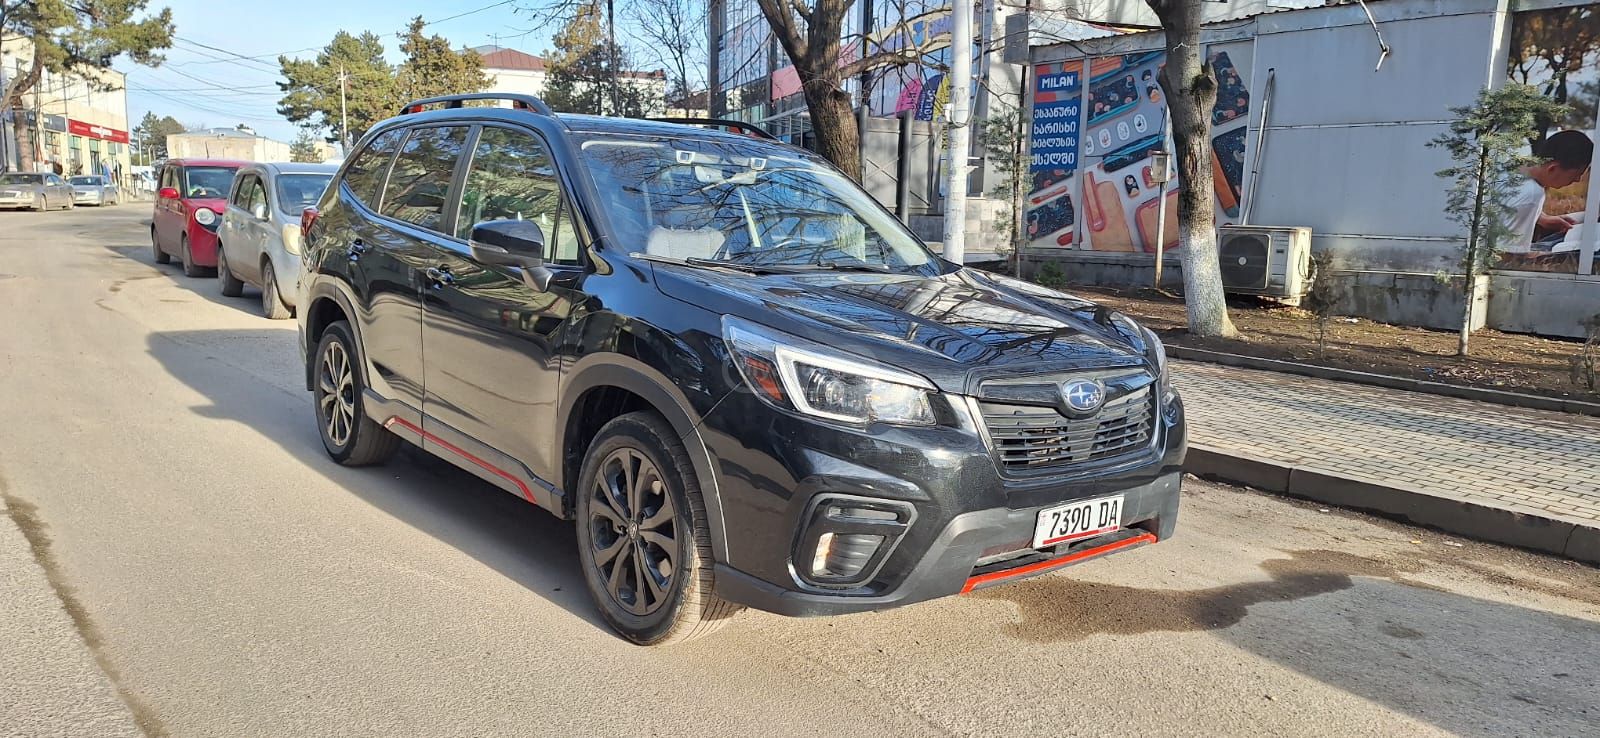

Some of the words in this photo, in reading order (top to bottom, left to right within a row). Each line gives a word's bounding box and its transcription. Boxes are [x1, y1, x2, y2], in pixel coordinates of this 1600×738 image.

[1041, 75, 1074, 89] MILAN
[1034, 105, 1078, 119] ესპანური
[1033, 121, 1076, 135] ხარისხი
[1048, 504, 1092, 538] 7390
[1098, 499, 1118, 528] DA
